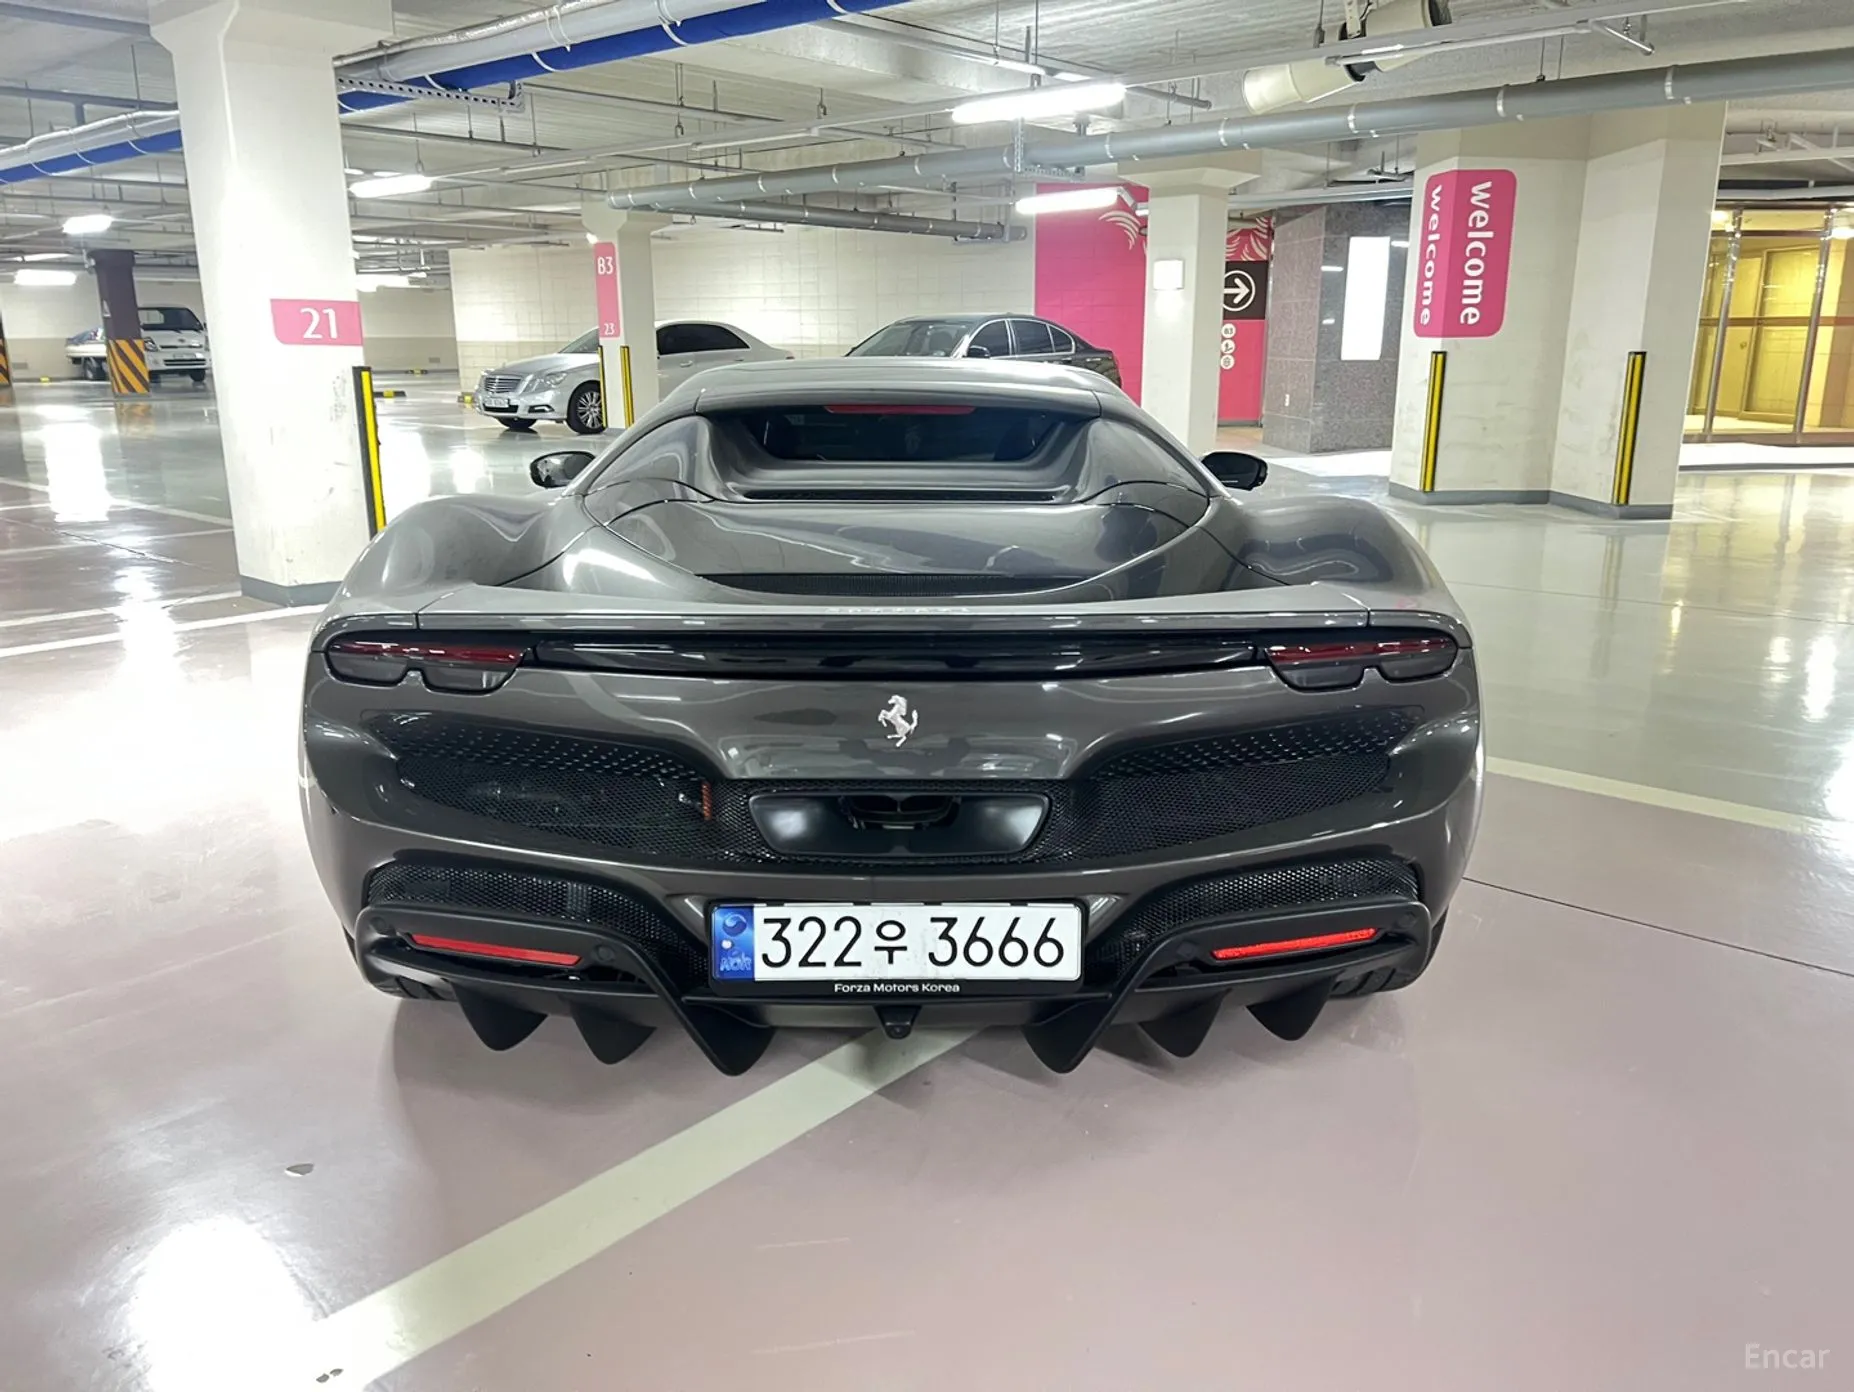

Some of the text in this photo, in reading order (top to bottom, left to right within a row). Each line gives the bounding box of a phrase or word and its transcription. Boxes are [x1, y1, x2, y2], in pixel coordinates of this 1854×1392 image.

[597, 256, 614, 275] B3
[1420, 184, 1442, 326] welcome
[1460, 181, 1494, 325] welcome
[300, 307, 338, 340] 21
[604, 322, 615, 335] 23
[761, 916, 1065, 968] 322우 3666
[834, 983, 960, 993] Forza Motors Korea
